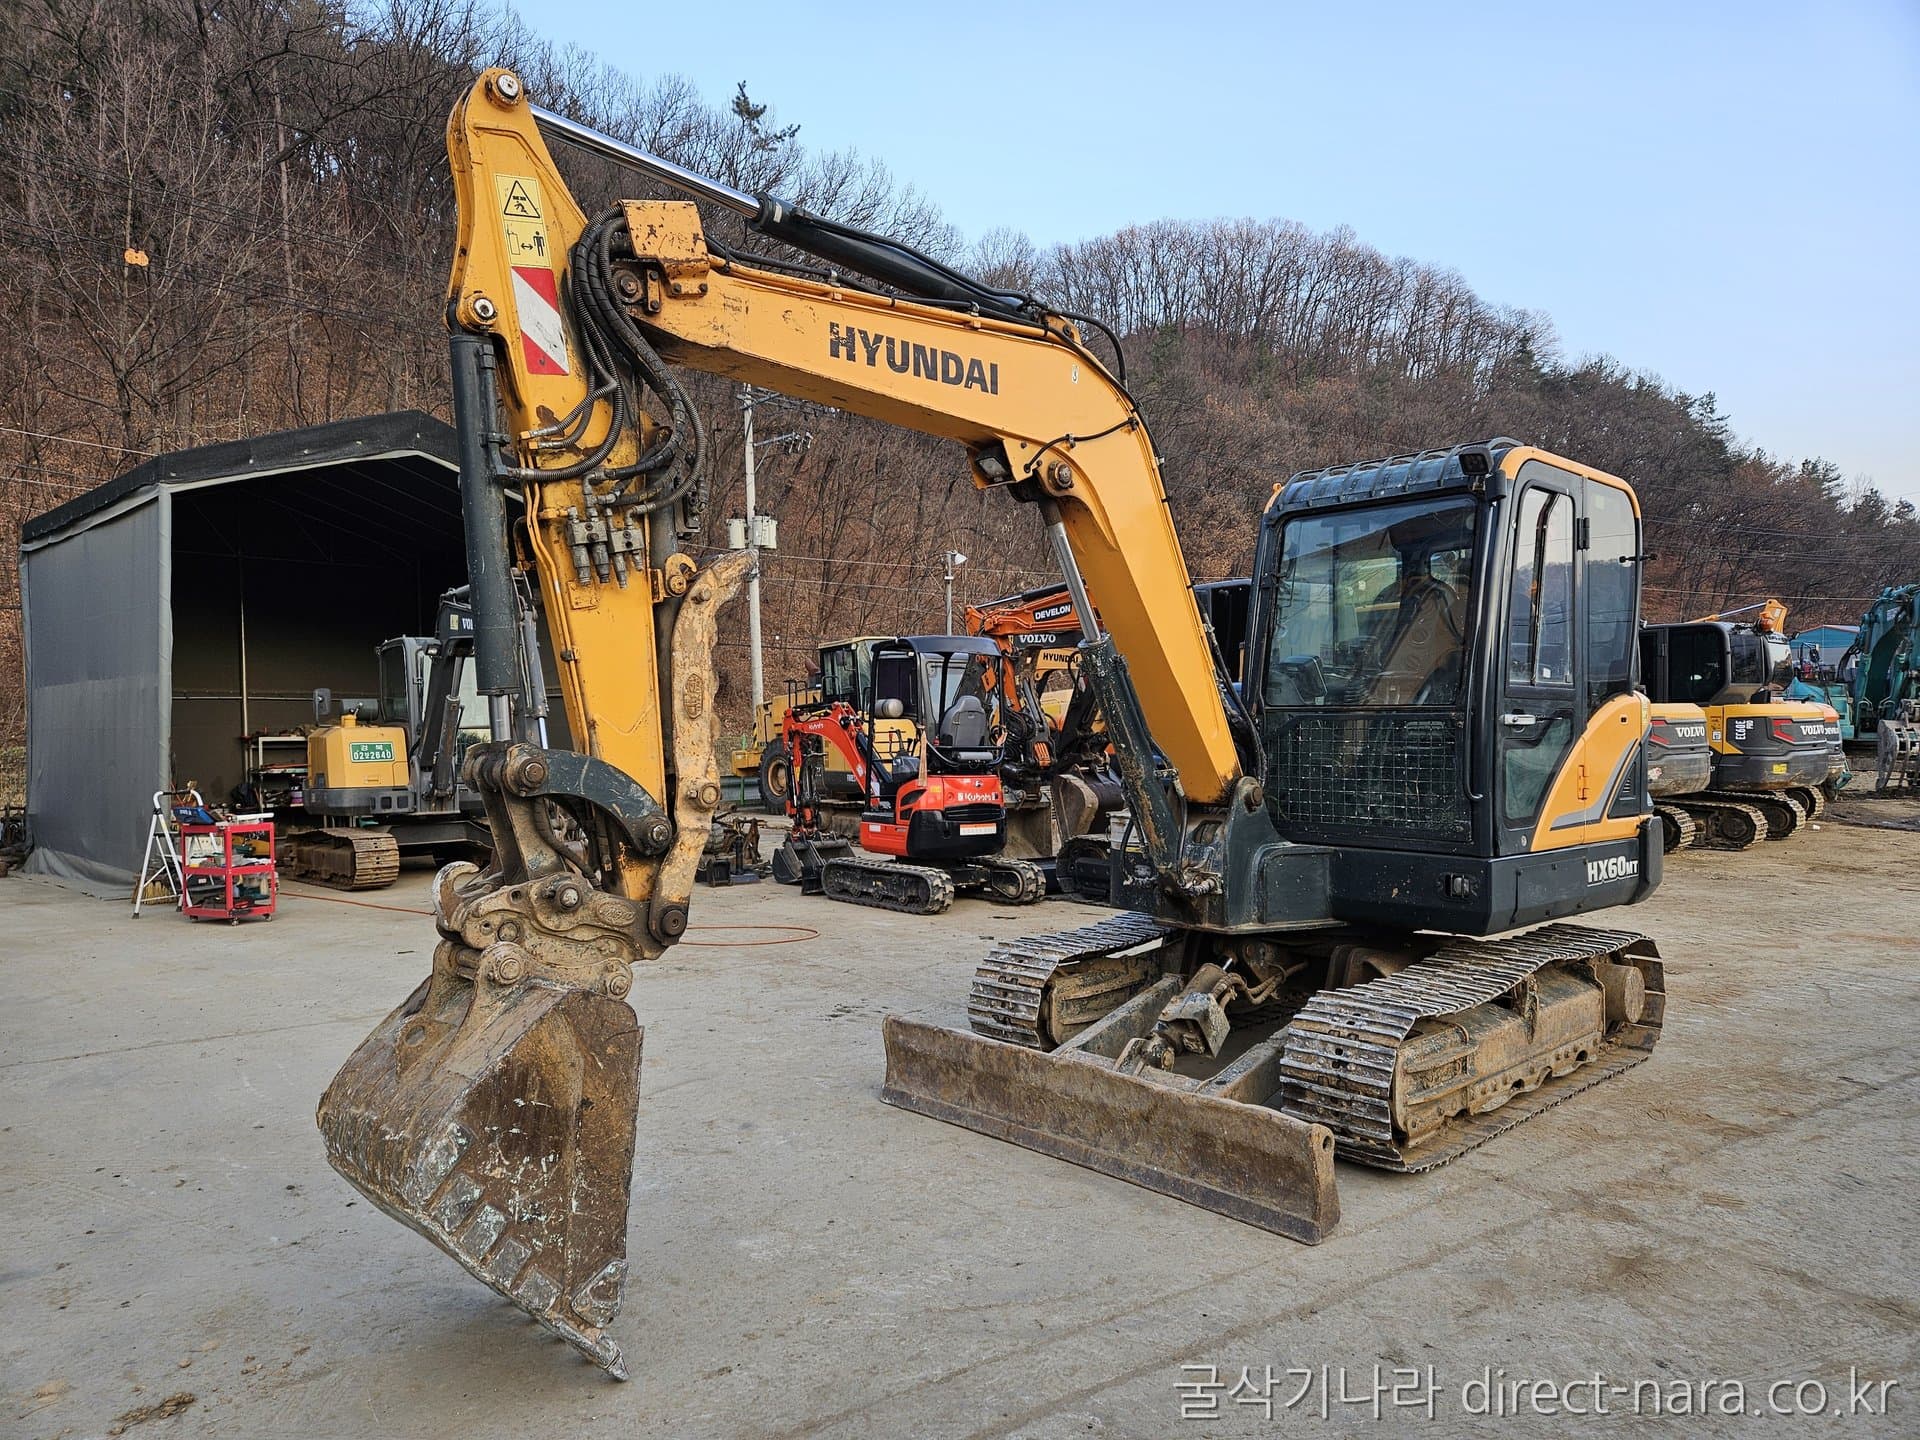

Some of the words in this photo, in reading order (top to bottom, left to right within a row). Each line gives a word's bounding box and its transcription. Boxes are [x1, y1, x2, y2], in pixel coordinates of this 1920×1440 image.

[829, 322, 999, 395] HYUNDAI
[1035, 604, 1071, 620] DEVELON
[1019, 634, 1056, 643] VOLVO
[1042, 652, 1079, 663] HYUNDAI
[1675, 726, 1705, 737] VOLVO
[1735, 720, 1746, 740] EC60E
[964, 793, 992, 801] Kubota
